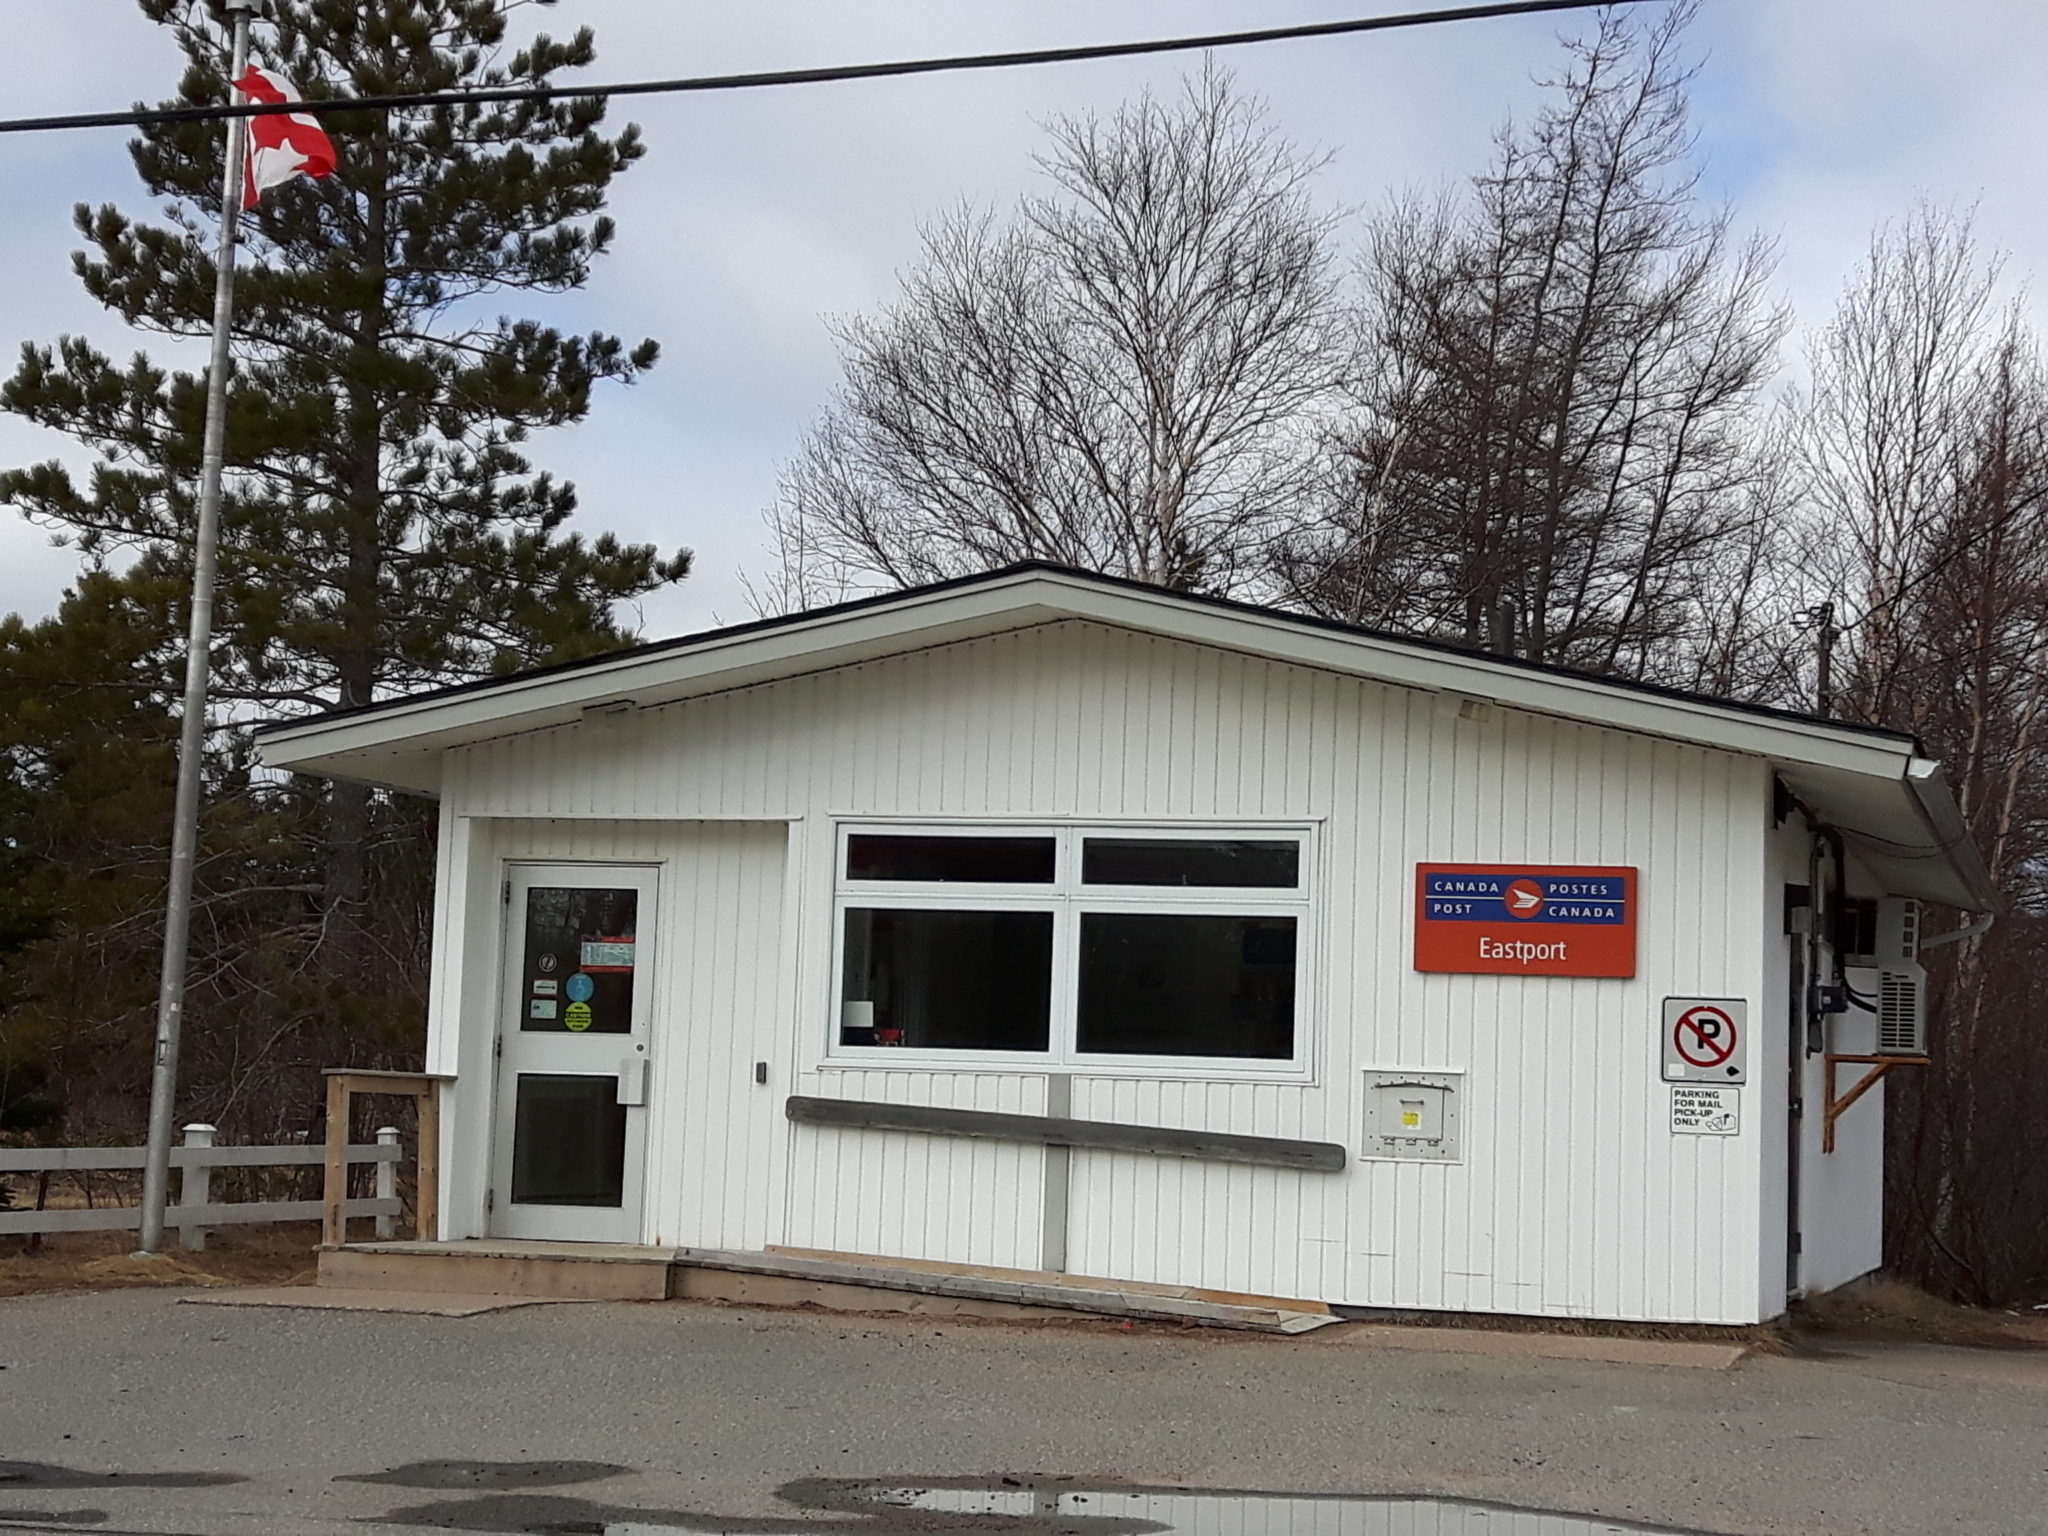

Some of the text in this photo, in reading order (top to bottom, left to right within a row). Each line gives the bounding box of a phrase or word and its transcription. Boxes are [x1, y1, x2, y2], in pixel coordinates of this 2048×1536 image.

[1434, 881, 1499, 893] CANADA
[1550, 884, 1608, 895] POSTES
[1434, 903, 1472, 914] POST
[1549, 906, 1614, 917] CANADA
[1480, 938, 1566, 964] Eastport
[1698, 1018, 1721, 1049] P
[1674, 1090, 1720, 1099] PARKING
[1674, 1099, 1723, 1108] FOR MAIL
[1674, 1108, 1713, 1117] PICK-UP
[1674, 1117, 1700, 1126] ONLY
